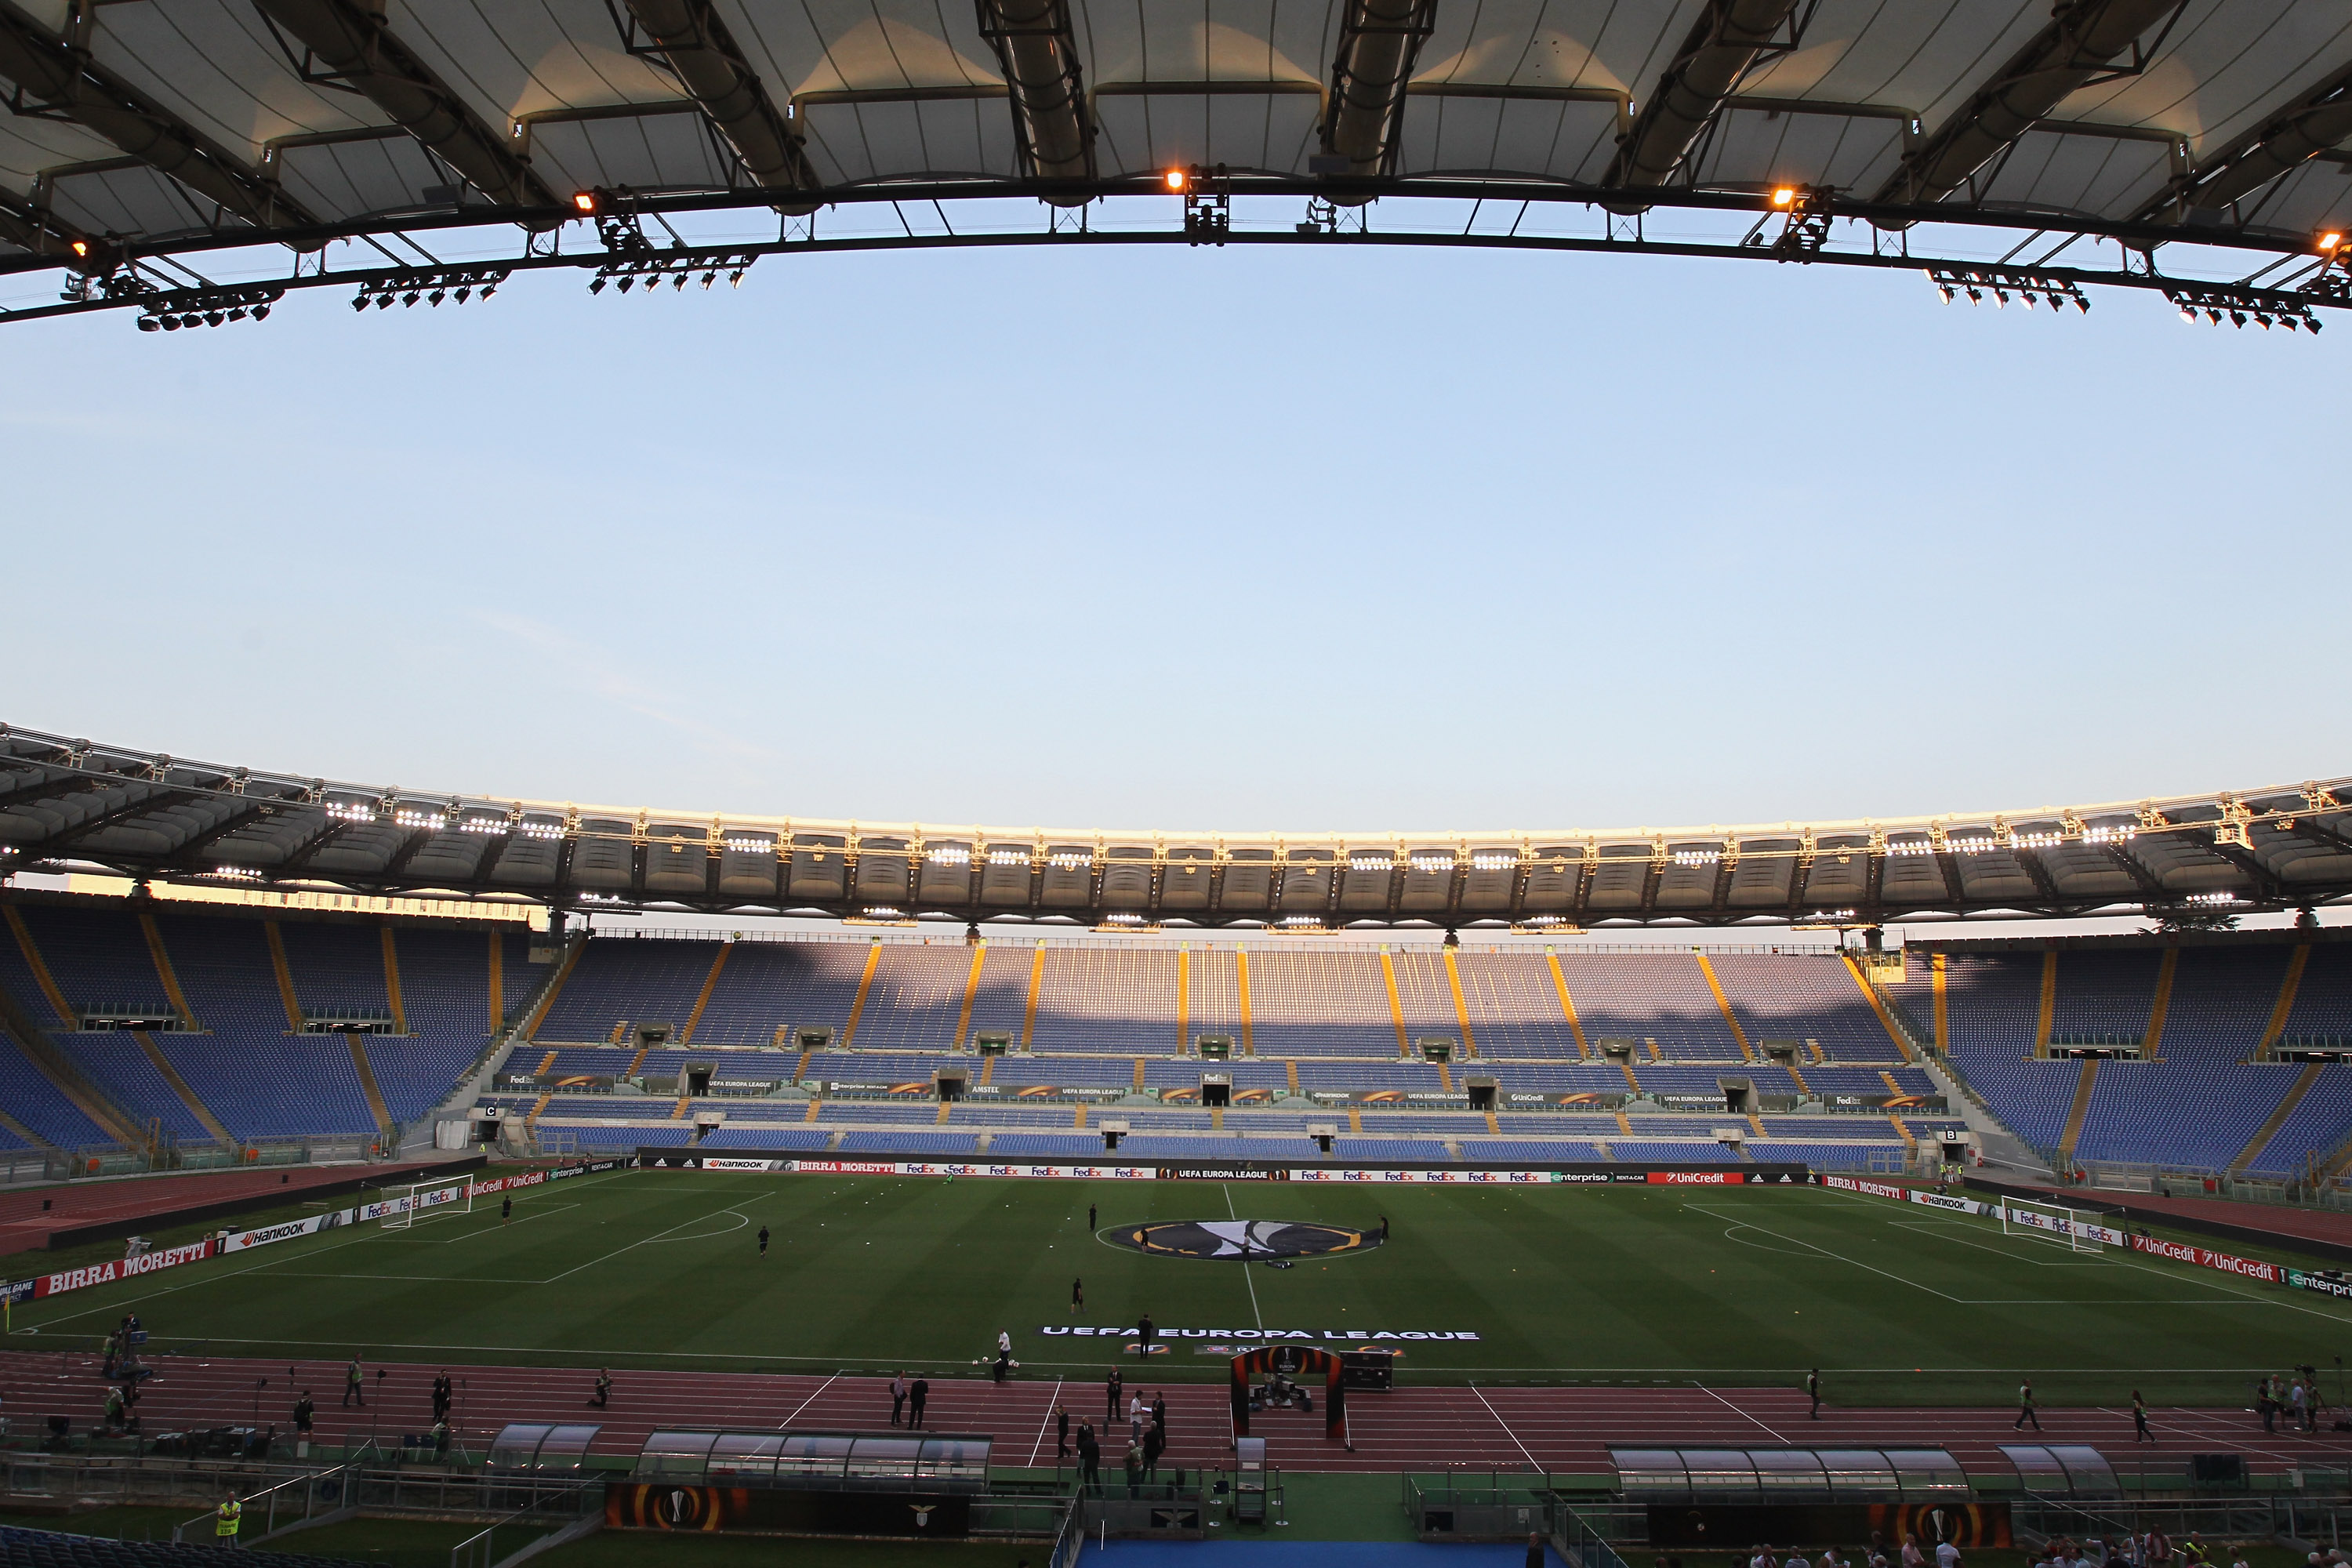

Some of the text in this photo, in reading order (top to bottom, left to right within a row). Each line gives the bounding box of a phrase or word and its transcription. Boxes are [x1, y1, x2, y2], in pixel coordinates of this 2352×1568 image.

[550, 1162, 613, 1178] enterprise RENT-A-CAR
[800, 1162, 895, 1173] BIRRA MORETTI
[906, 1164, 935, 1174] FedEx
[949, 1165, 977, 1174] FedEx
[989, 1166, 1018, 1175] FedEx
[1032, 1167, 1060, 1176] FedEx
[1073, 1167, 1102, 1177] FedEx
[1115, 1168, 1144, 1178] FedEx
[1301, 1171, 1330, 1180] FedEx
[1343, 1171, 1372, 1181] FedEx
[1385, 1172, 1414, 1181] FedEx
[1427, 1172, 1455, 1181] FedEx
[1468, 1173, 1497, 1181] FedEx
[1510, 1173, 1538, 1182] FedEx
[1552, 1173, 1608, 1182] enterprise
[1677, 1173, 1724, 1183] UniCredit
[513, 1172, 543, 1187] UniCredit
[472, 1179, 503, 1196] UniCredit
[1827, 1176, 1900, 1199] BIRRA MORETTI
[430, 1190, 450, 1204] FedEx
[368, 1203, 391, 1218] FedEx
[2020, 1211, 2044, 1227] FedEx
[2087, 1225, 2112, 1243] FedEx
[2145, 1239, 2196, 1262] UniCredit
[48, 1242, 205, 1294] BIRRA MORETTI
[2214, 1254, 2274, 1281] UniCredit
[13, 1281, 33, 1293] GAME
[1043, 1327, 1480, 1340] UEFA EUROPA LEAGUE
